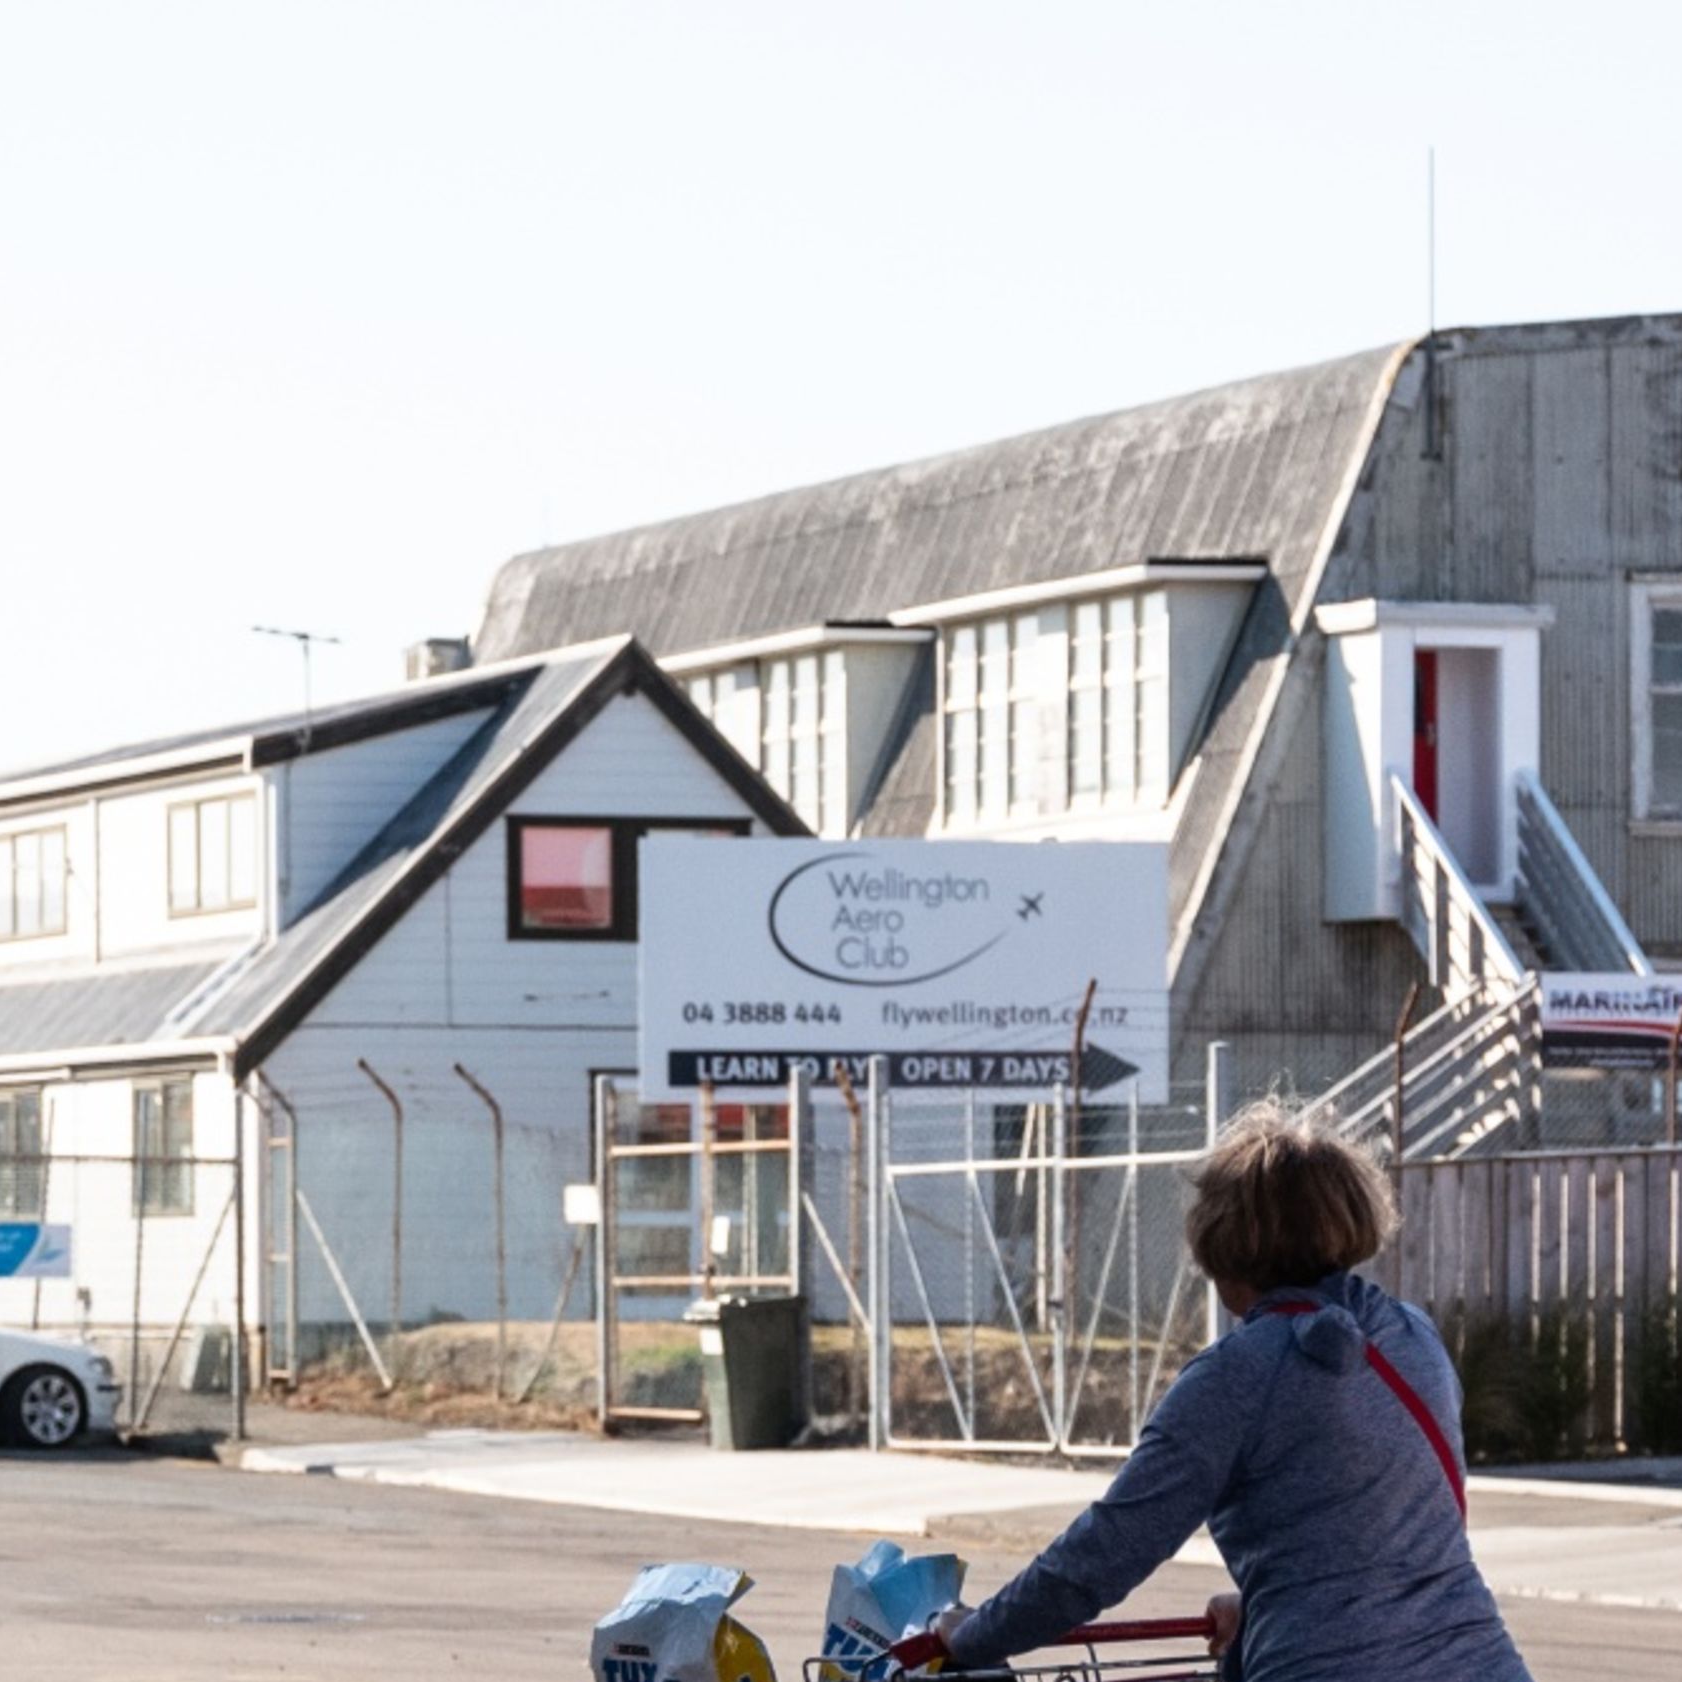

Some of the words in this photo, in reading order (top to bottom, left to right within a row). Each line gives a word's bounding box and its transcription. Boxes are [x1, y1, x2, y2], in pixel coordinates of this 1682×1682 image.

[826, 868, 991, 910] Wellington
[830, 903, 906, 934] Aero
[835, 935, 911, 970] Club
[682, 1002, 715, 1024] 04
[722, 1002, 787, 1025] 3888
[793, 1003, 842, 1024] 444
[696, 1056, 780, 1081] LEARN
[901, 1056, 972, 1082] OPEN
[980, 1057, 996, 1081] 7
[1002, 1056, 1070, 1082] DAYS
